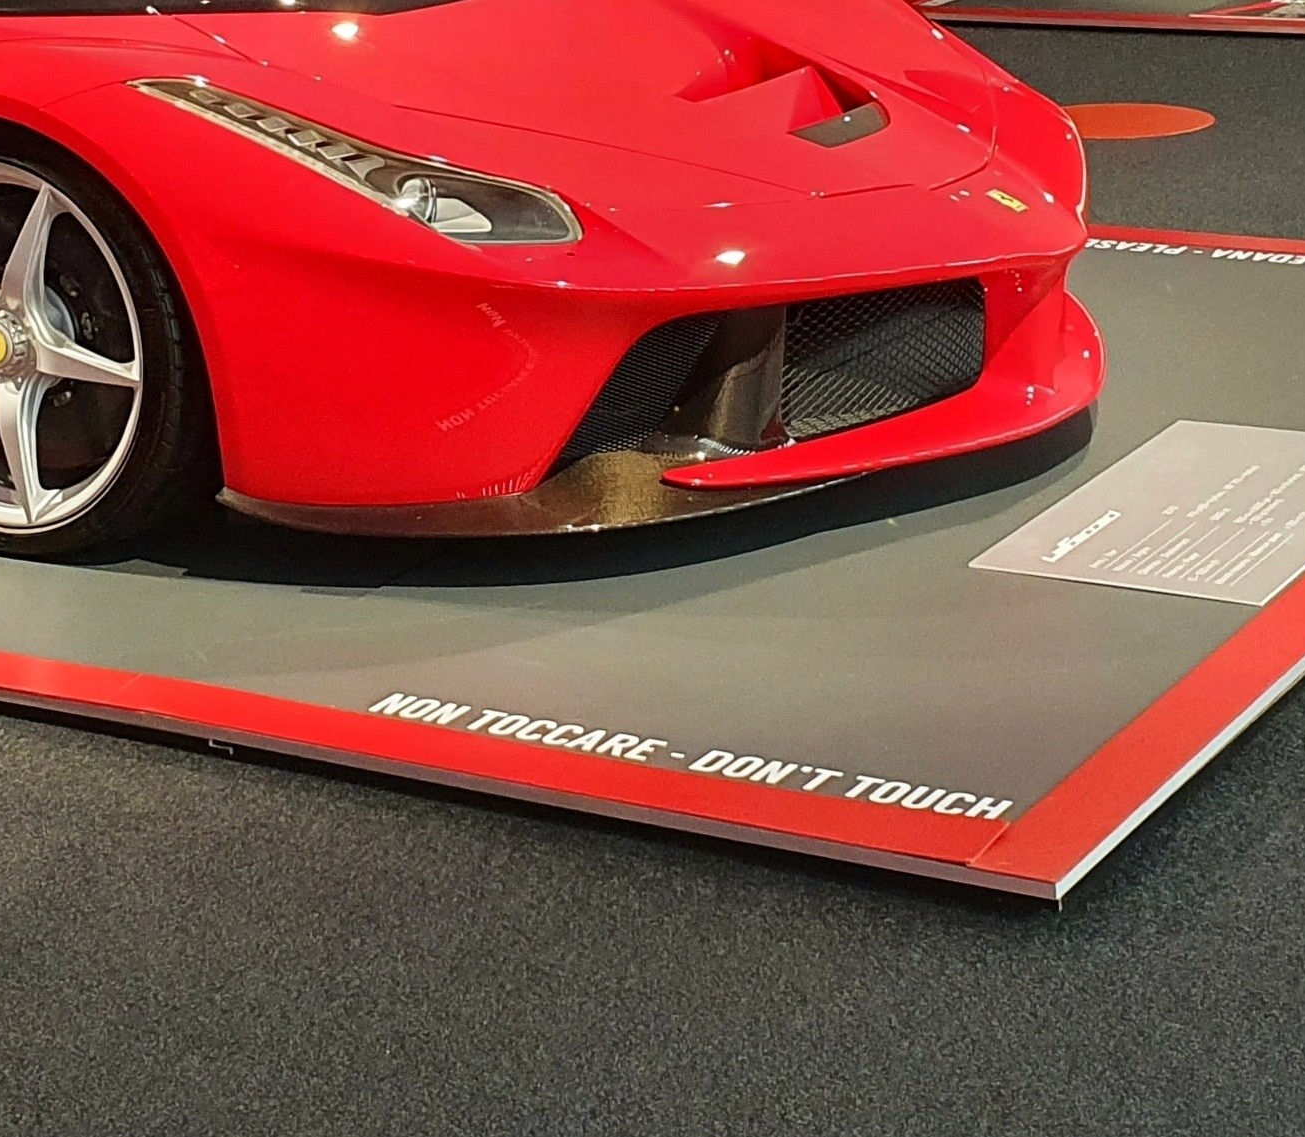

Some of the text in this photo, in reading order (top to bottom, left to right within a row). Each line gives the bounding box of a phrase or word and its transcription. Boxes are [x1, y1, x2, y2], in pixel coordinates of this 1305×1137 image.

[368, 693, 472, 725] NON
[466, 709, 668, 762] TOCCARE
[688, 749, 844, 790] DON'T
[844, 775, 1014, 820] TOUCH
